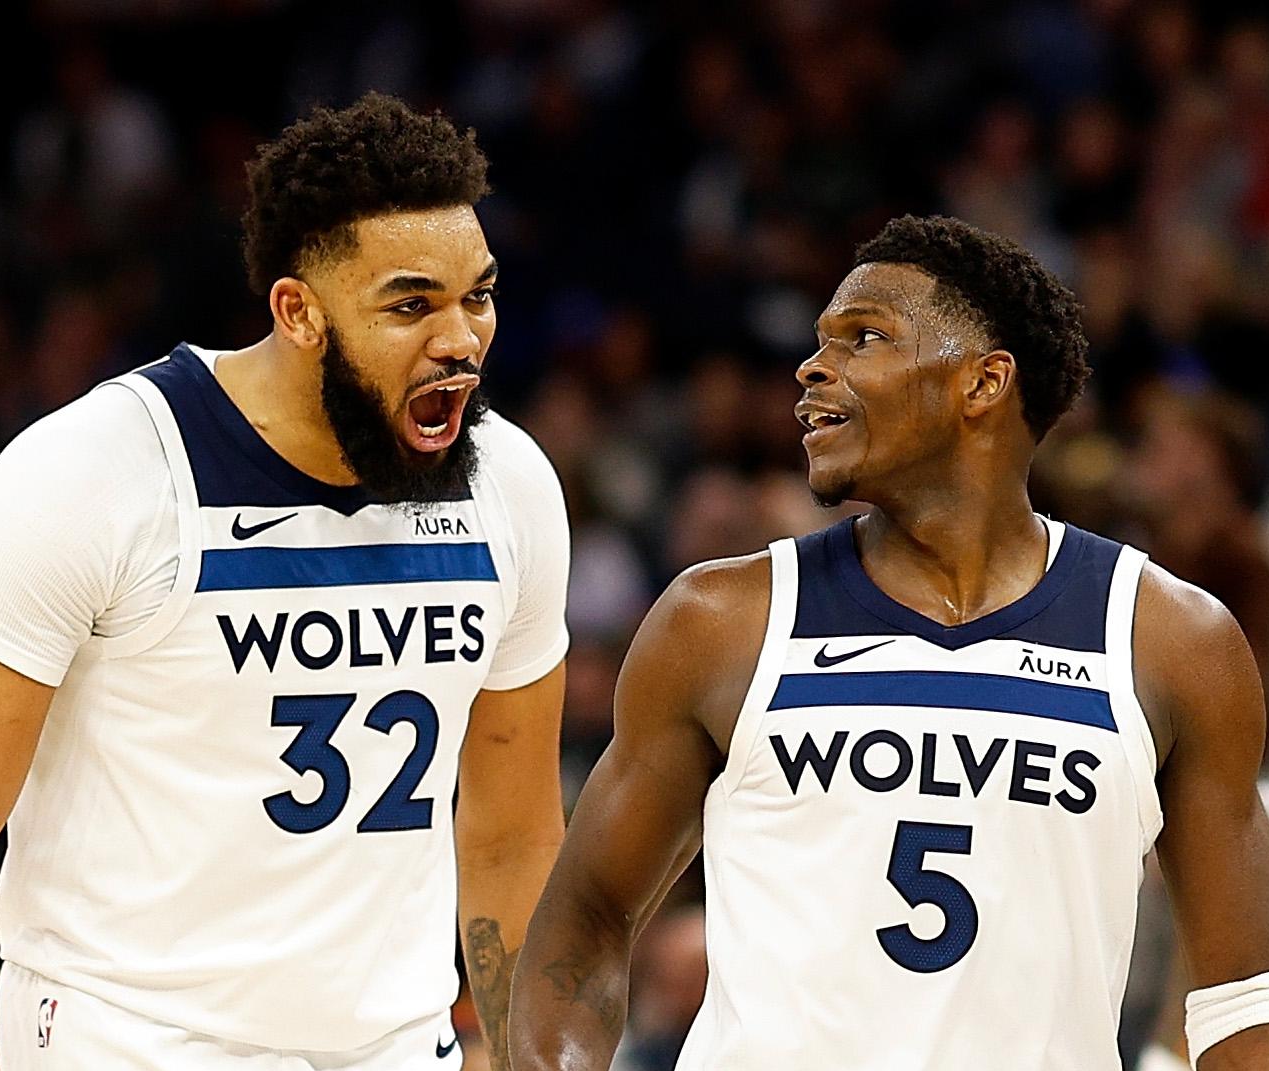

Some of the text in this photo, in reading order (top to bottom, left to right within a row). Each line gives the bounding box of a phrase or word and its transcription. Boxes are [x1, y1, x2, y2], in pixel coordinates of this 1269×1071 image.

[217, 604, 485, 674] WOLVES
[263, 690, 440, 834] 32
[769, 730, 1102, 814] WOLVES
[876, 820, 979, 974] 5
